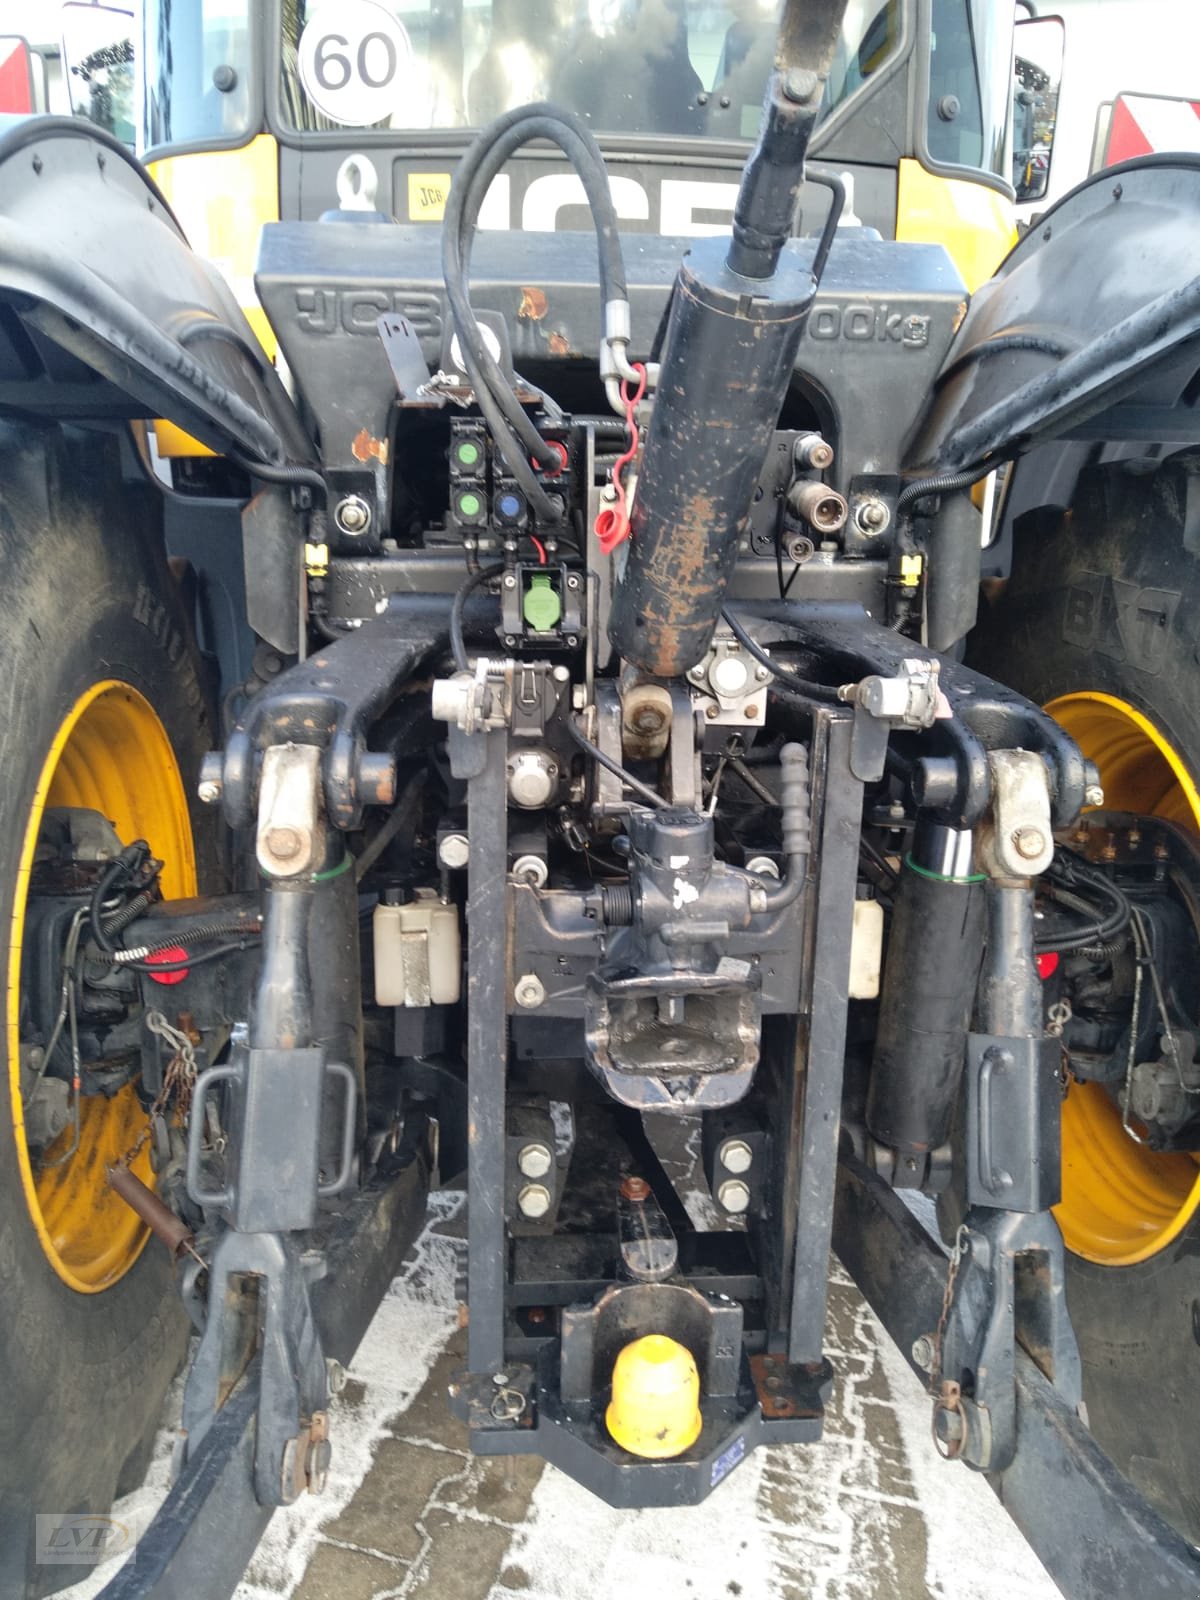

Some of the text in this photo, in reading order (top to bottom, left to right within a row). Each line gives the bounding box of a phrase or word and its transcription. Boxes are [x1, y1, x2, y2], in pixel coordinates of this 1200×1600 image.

[314, 31, 398, 91] 60
[420, 187, 442, 207] JCB
[295, 288, 442, 337] JCB
[807, 303, 931, 349] 00kg
